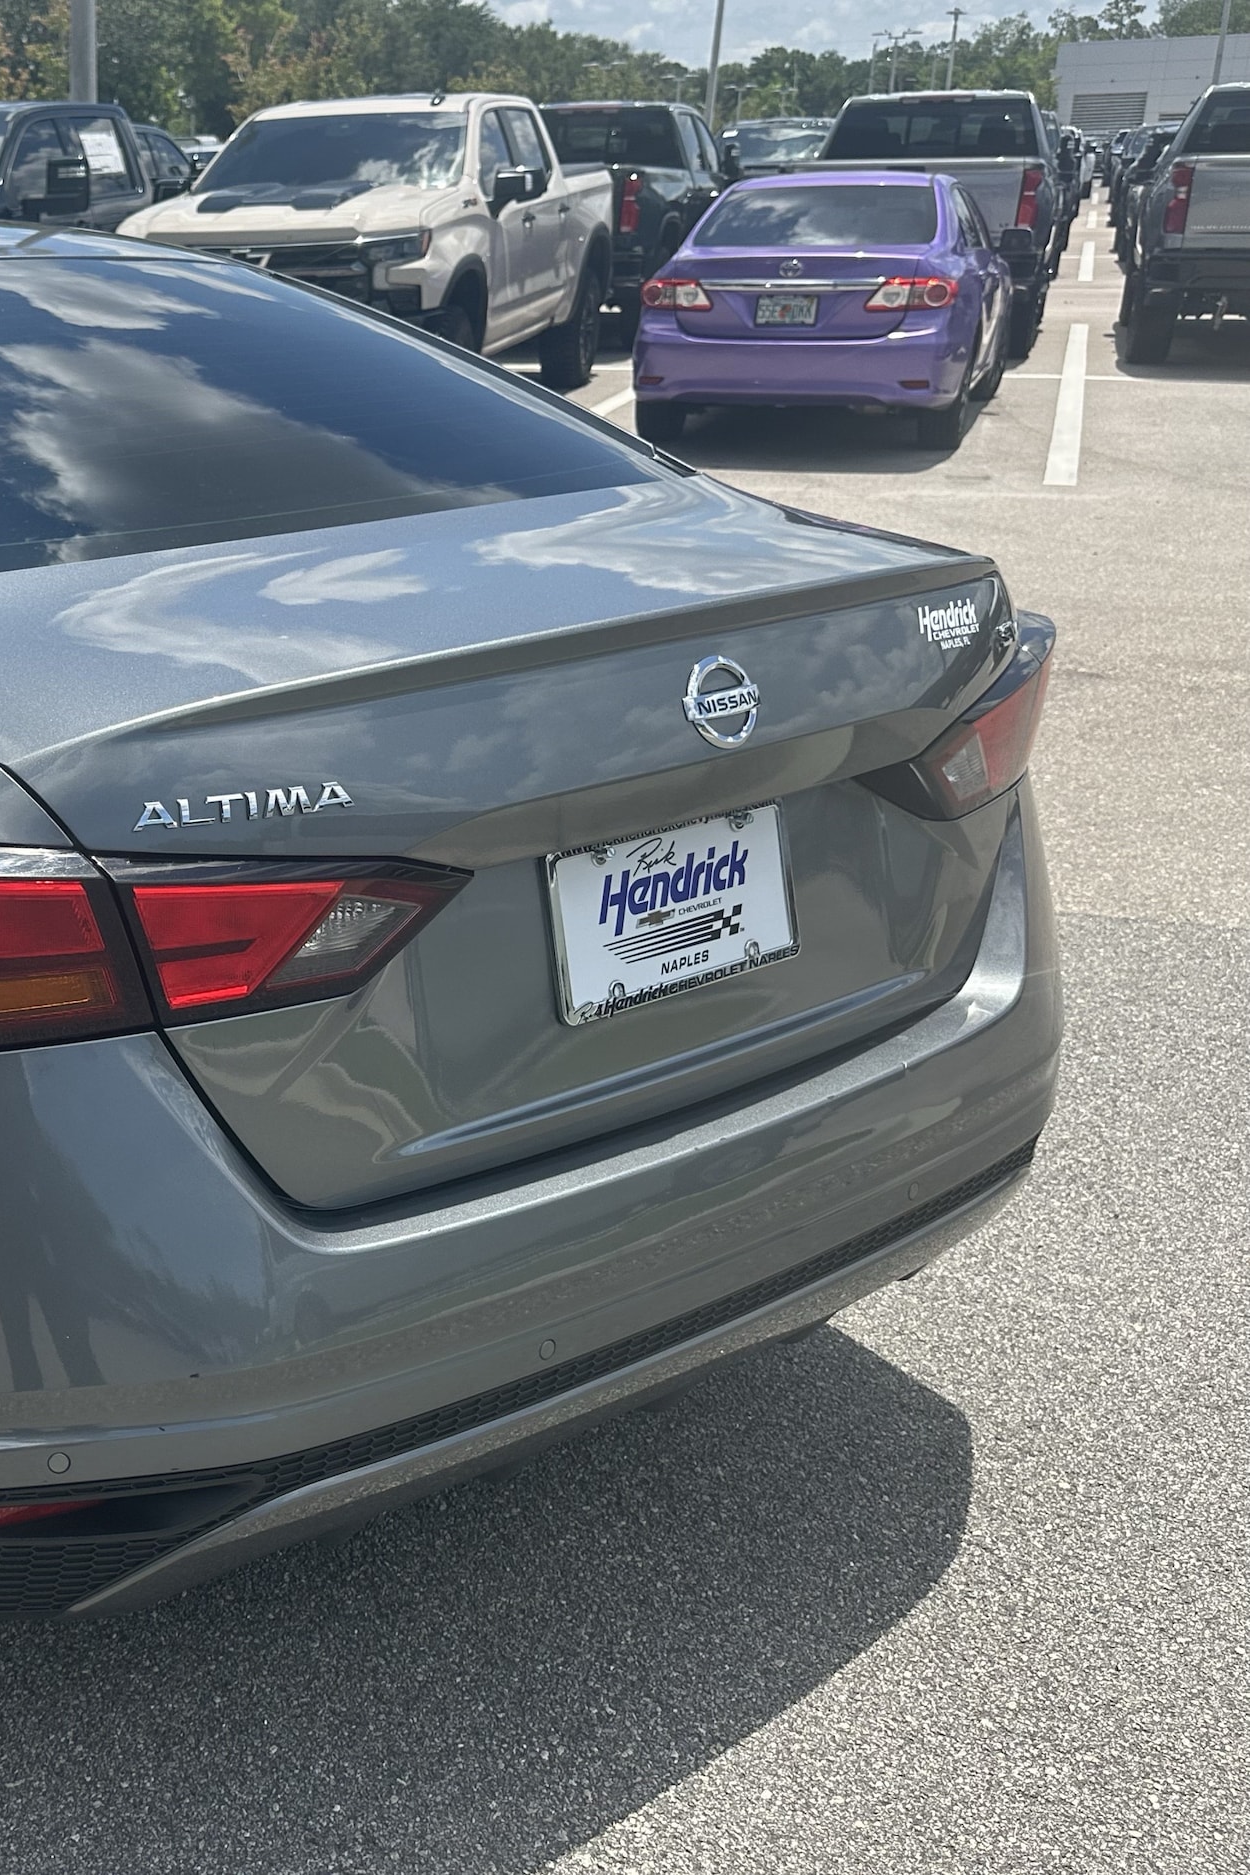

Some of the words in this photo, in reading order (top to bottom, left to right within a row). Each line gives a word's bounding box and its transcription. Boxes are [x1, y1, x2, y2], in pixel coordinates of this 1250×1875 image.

[917, 597, 977, 642] Hendrick
[932, 623, 980, 641] CHEVROLET
[697, 689, 757, 715] NISSAN
[133, 781, 355, 832] ALTIMA
[626, 837, 677, 877] Rick
[598, 840, 749, 937] Hendrick
[678, 896, 723, 916] CHEVROLET
[660, 949, 710, 976] NAPLES
[668, 958, 747, 995] CHEVROLET
[749, 945, 800, 970] NAPLES
